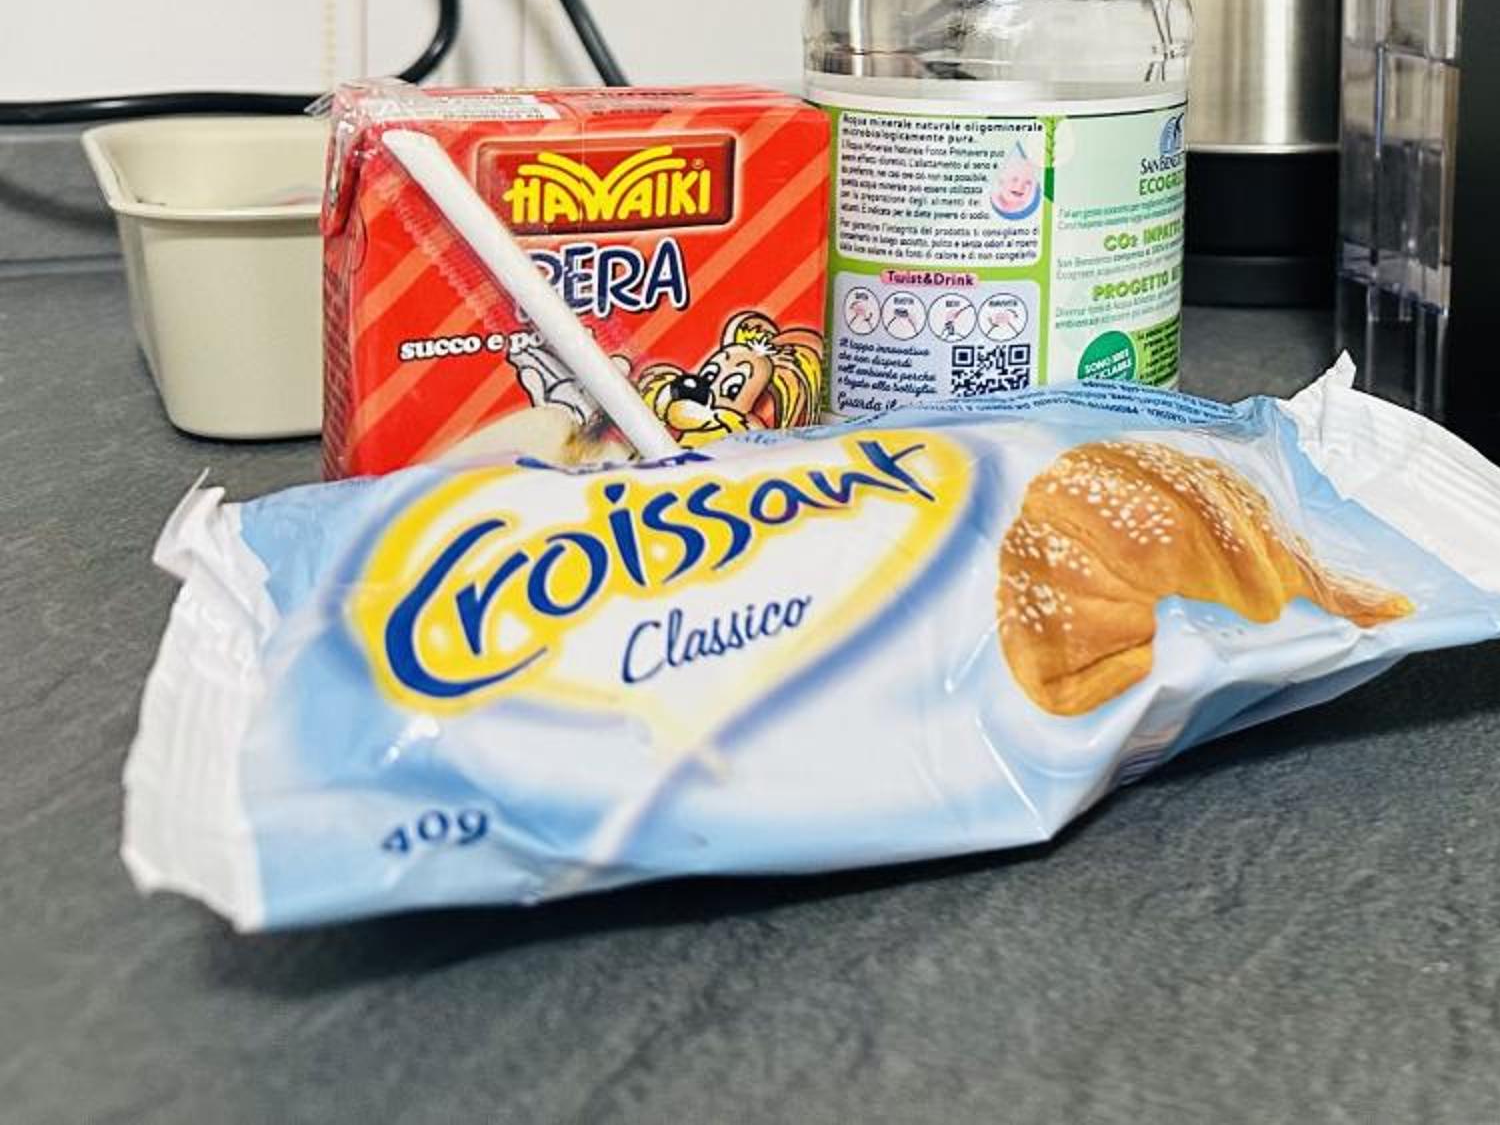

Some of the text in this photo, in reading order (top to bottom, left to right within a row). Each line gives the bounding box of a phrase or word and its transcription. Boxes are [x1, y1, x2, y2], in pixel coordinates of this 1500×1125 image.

[869, 118, 912, 130] minerale
[914, 121, 961, 131] naturale
[964, 122, 1044, 135] oligominerale
[502, 145, 711, 224] HAWAIKI
[887, 270, 974, 287] Twist&Drink
[1092, 270, 1169, 302] PROGETTO
[400, 334, 483, 361] succo
[486, 332, 504, 350] e
[837, 390, 882, 412] Guarda
[384, 439, 937, 698] Croissant
[620, 594, 812, 685] Classico
